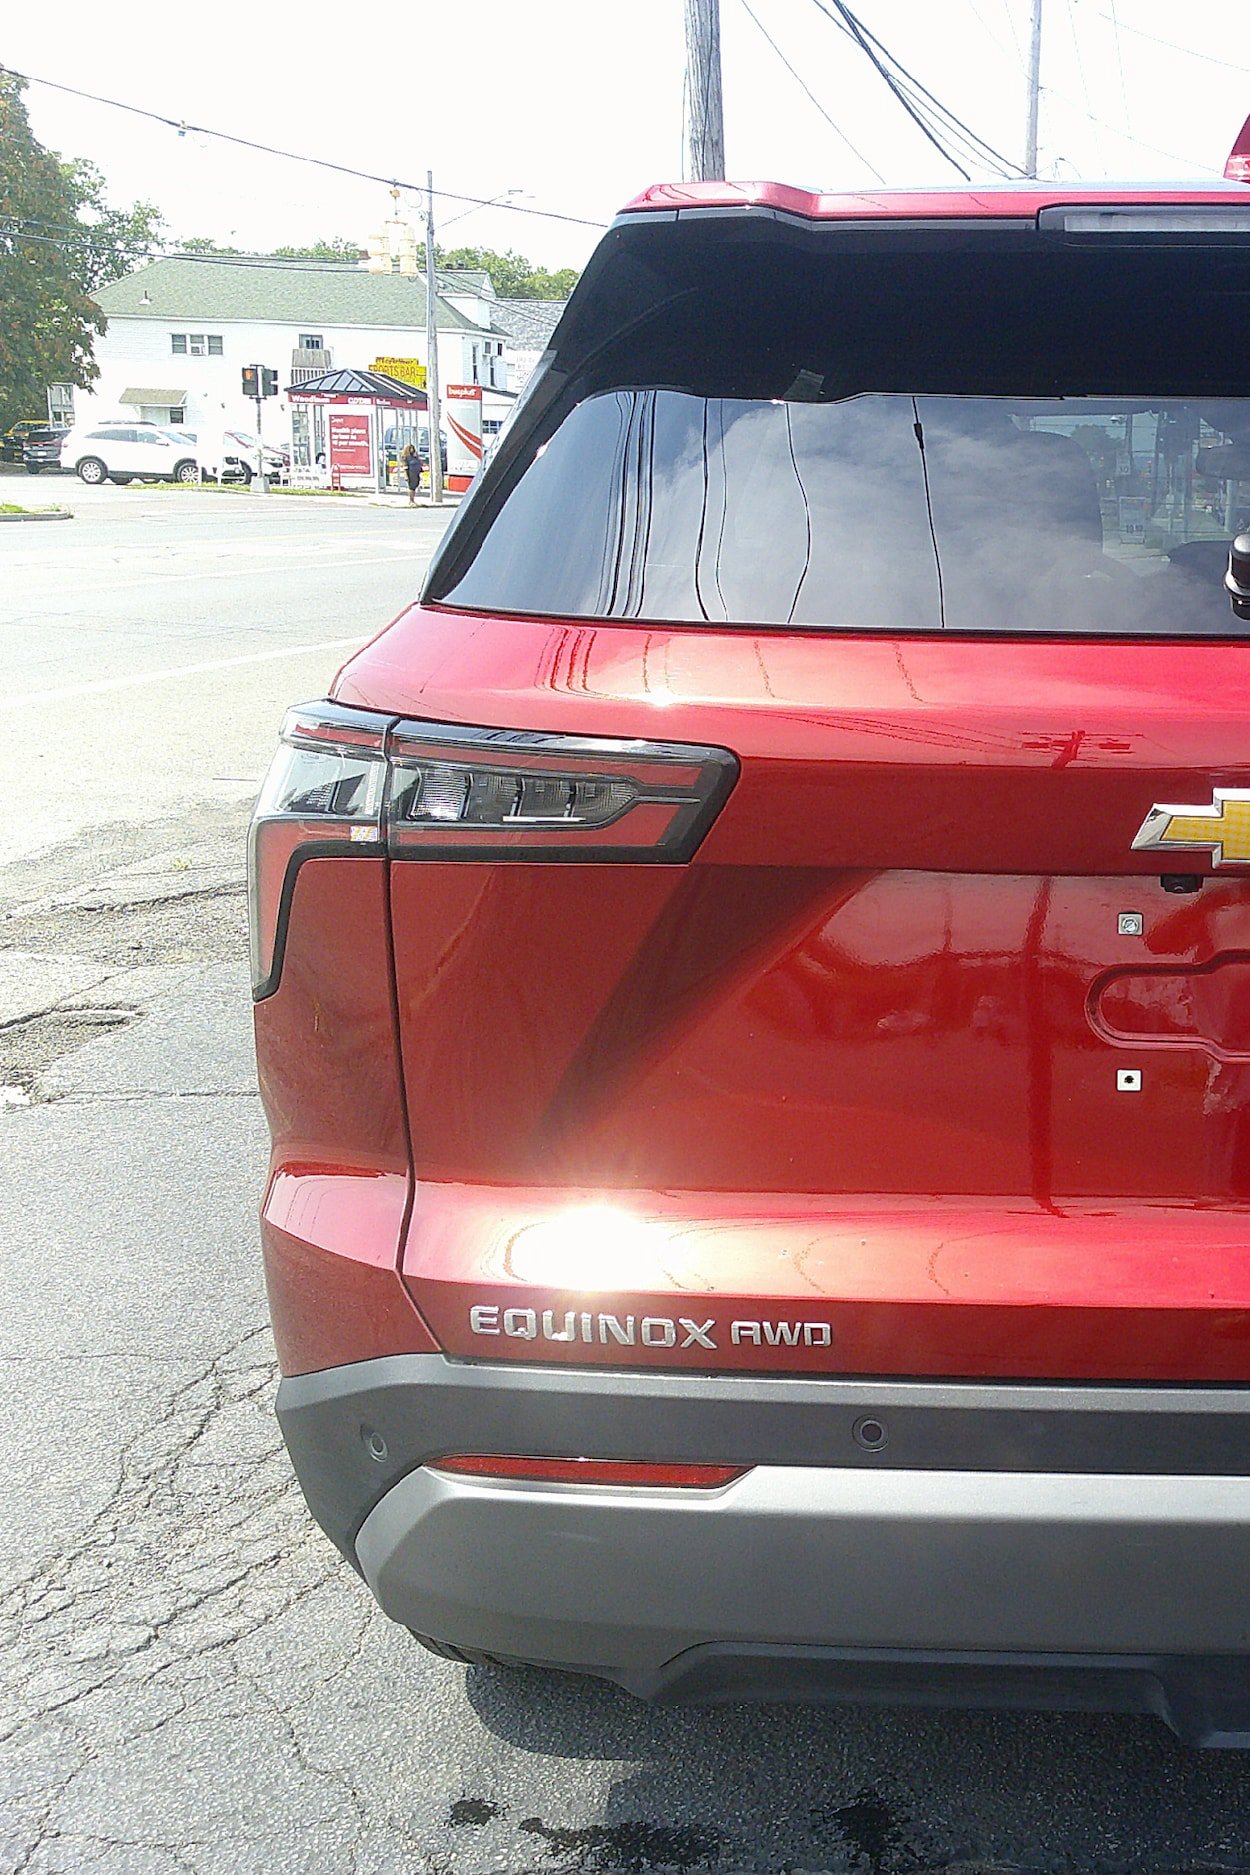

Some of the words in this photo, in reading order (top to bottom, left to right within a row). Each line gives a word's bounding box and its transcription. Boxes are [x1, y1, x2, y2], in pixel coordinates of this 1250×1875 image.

[400, 366, 416, 378] BAR
[469, 1304, 718, 1350] EQUINOX
[730, 1320, 833, 1348] AWD
